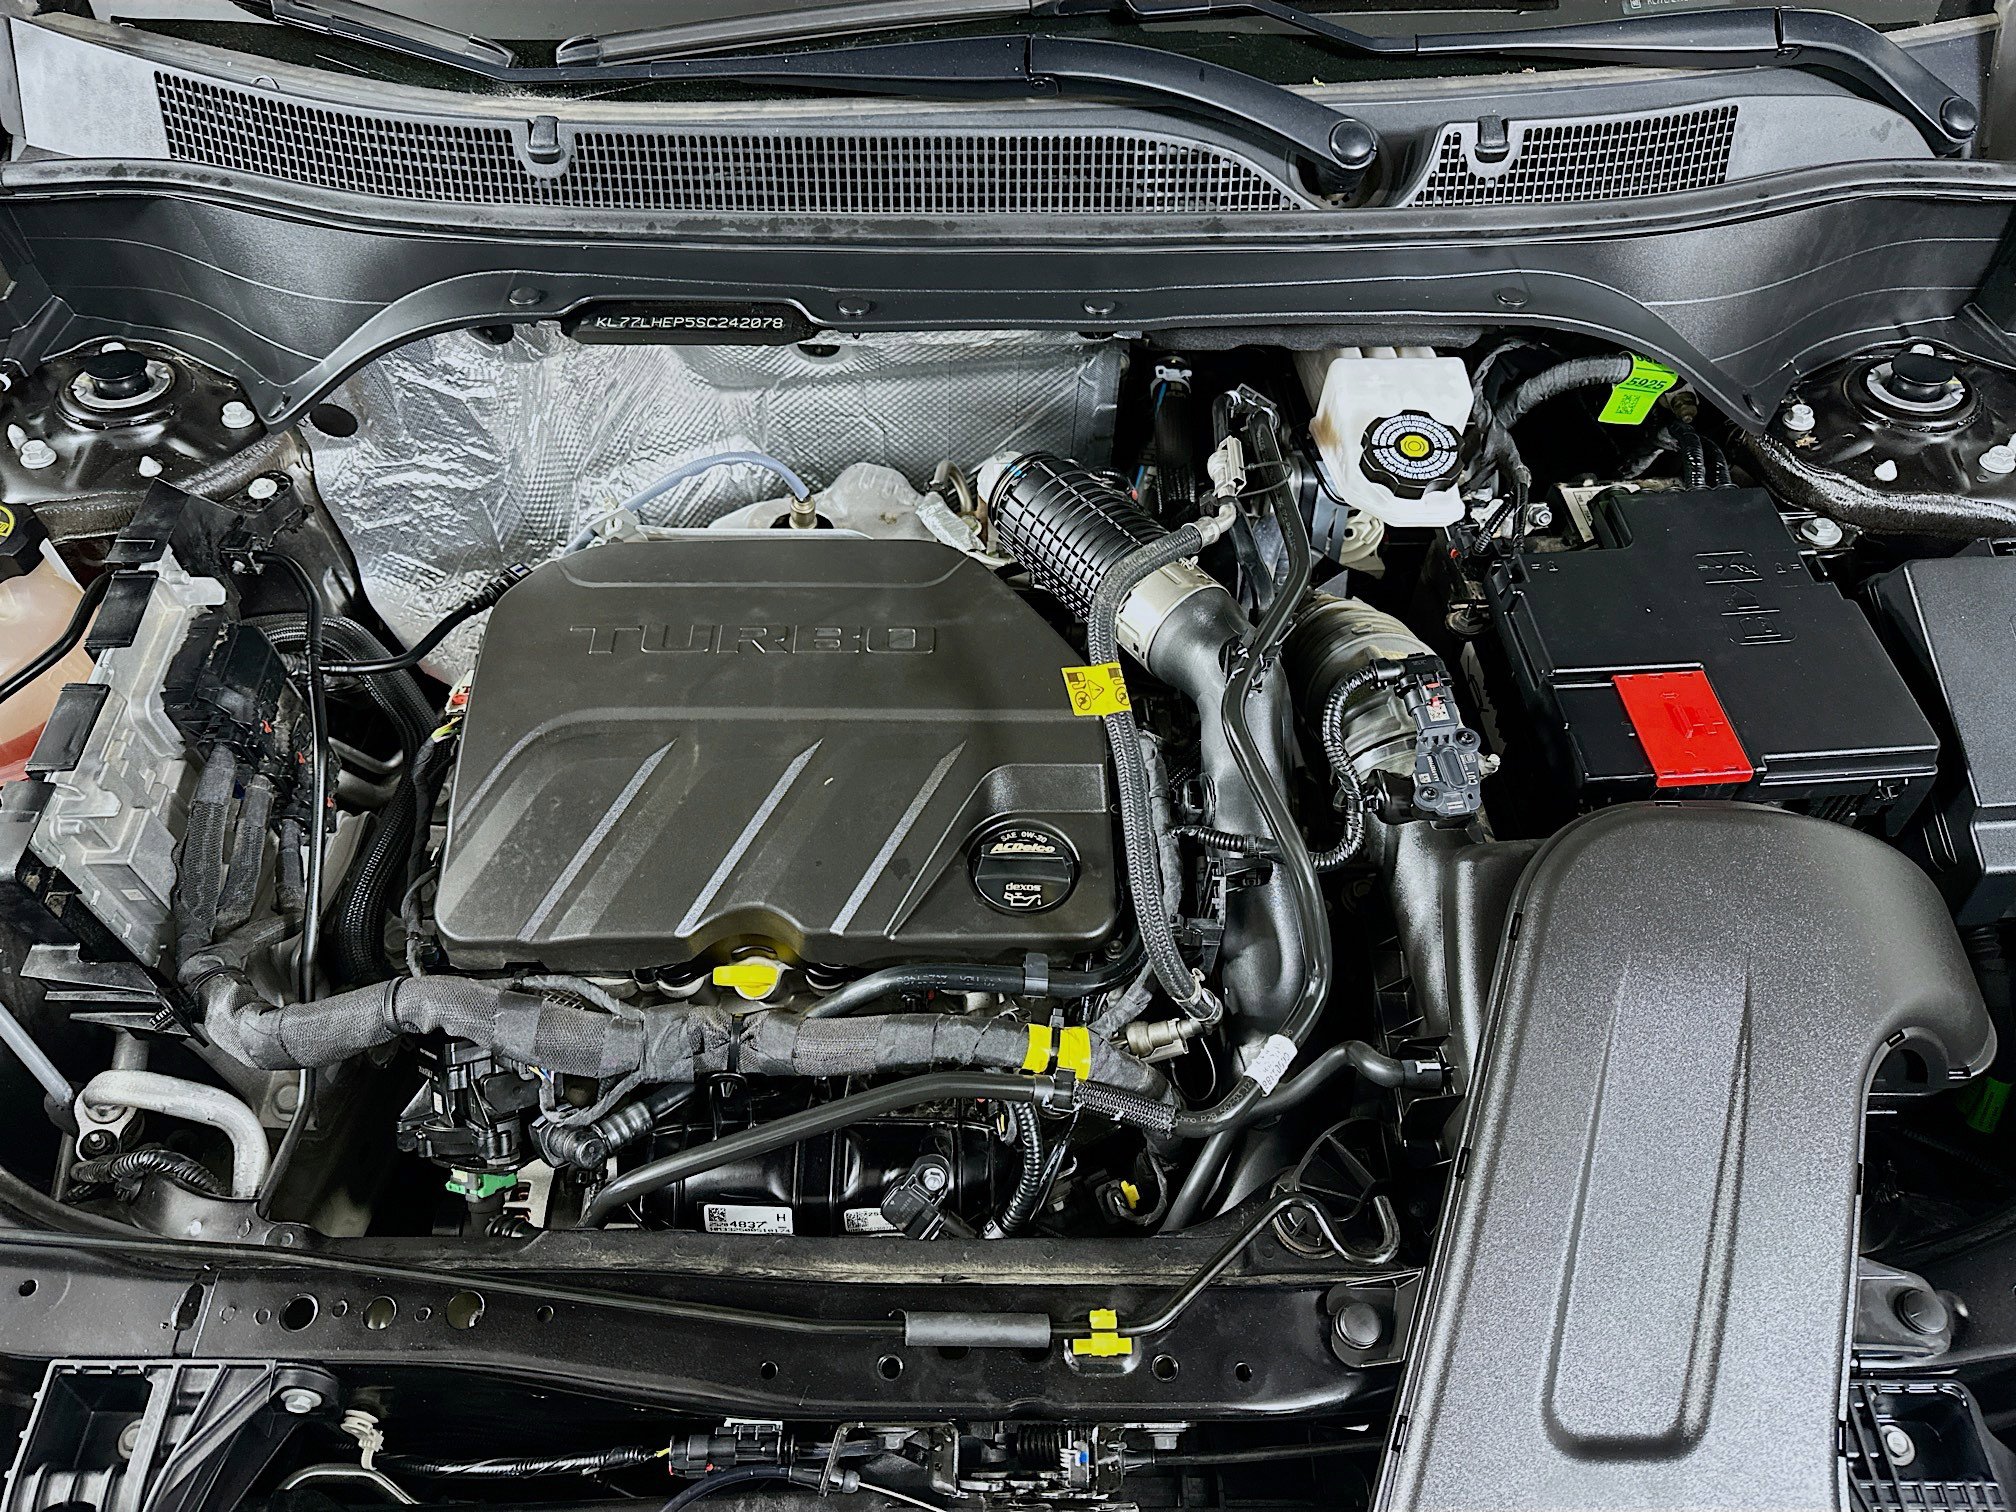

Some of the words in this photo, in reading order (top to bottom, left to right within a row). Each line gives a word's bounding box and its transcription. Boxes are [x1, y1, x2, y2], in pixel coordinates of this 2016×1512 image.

[596, 316, 784, 329] KL77LHEP5SC242078
[1626, 377, 1667, 390] 5925
[570, 624, 936, 654] TURBO
[1000, 831, 1018, 842] SAE
[1021, 831, 1048, 844] 0W-20
[989, 842, 1056, 855] ACDelco
[1005, 882, 1042, 892] dexos
[776, 1213, 786, 1222] H
